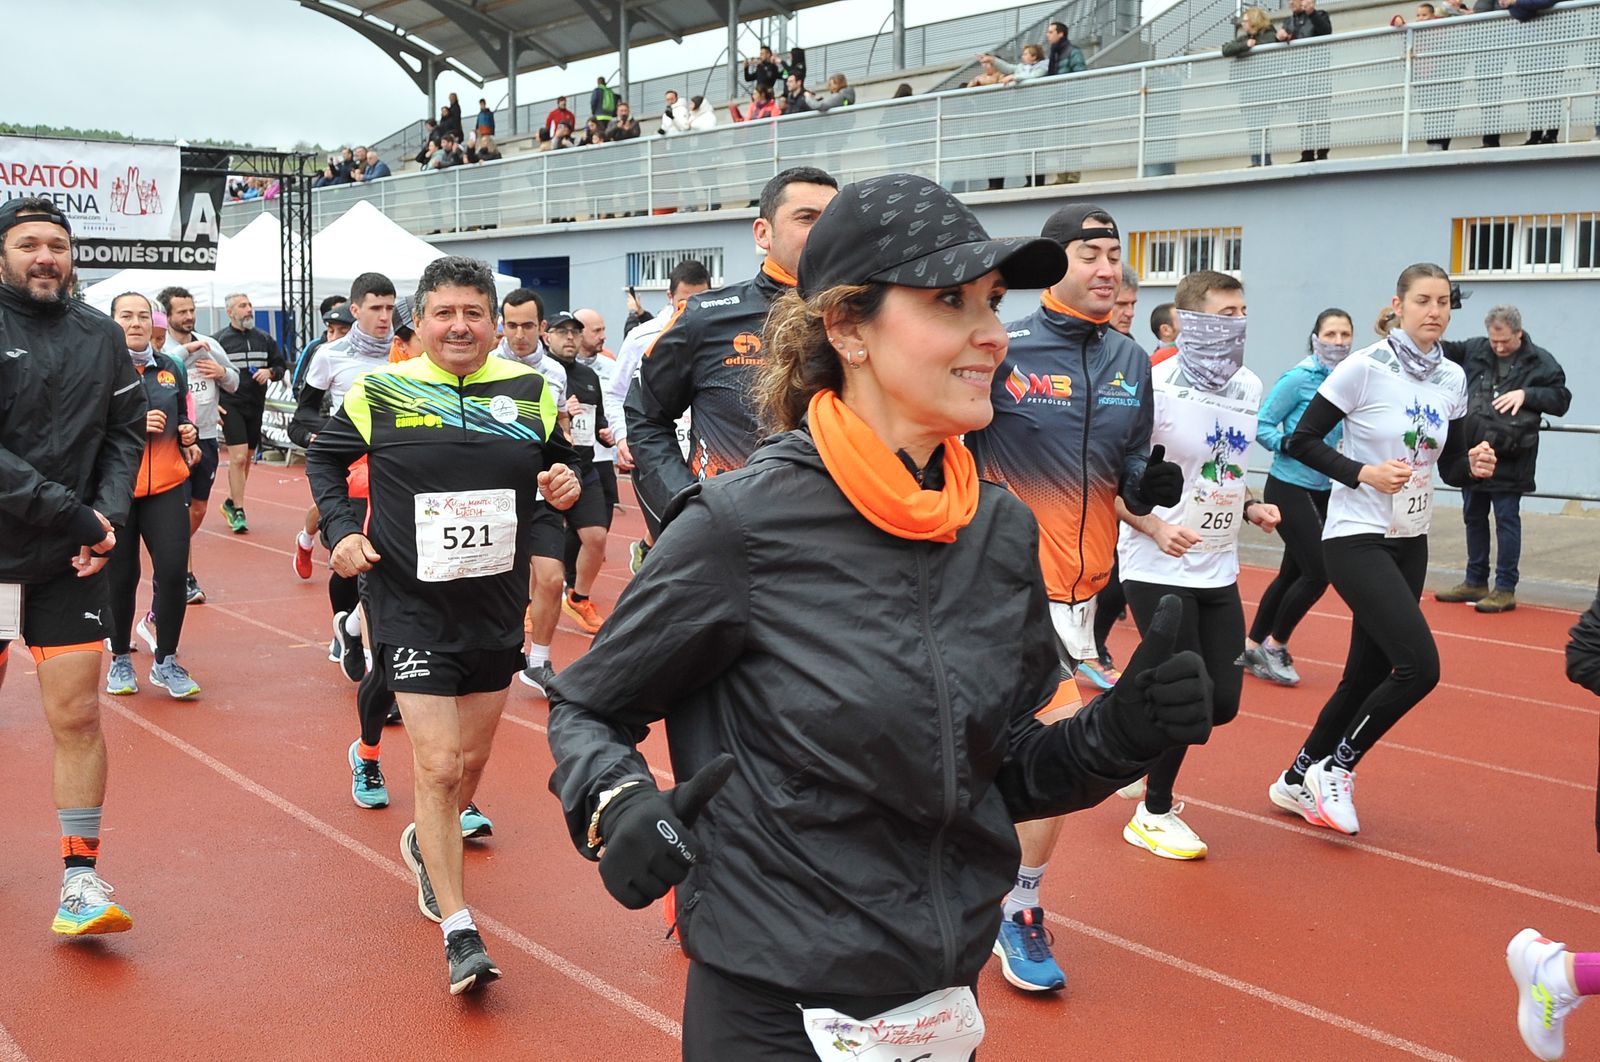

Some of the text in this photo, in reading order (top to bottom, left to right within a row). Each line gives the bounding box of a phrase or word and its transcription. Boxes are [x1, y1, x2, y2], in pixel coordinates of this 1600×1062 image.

[1407, 492, 1429, 515] 213
[1200, 511, 1234, 530] 269
[443, 524, 494, 550] 521
